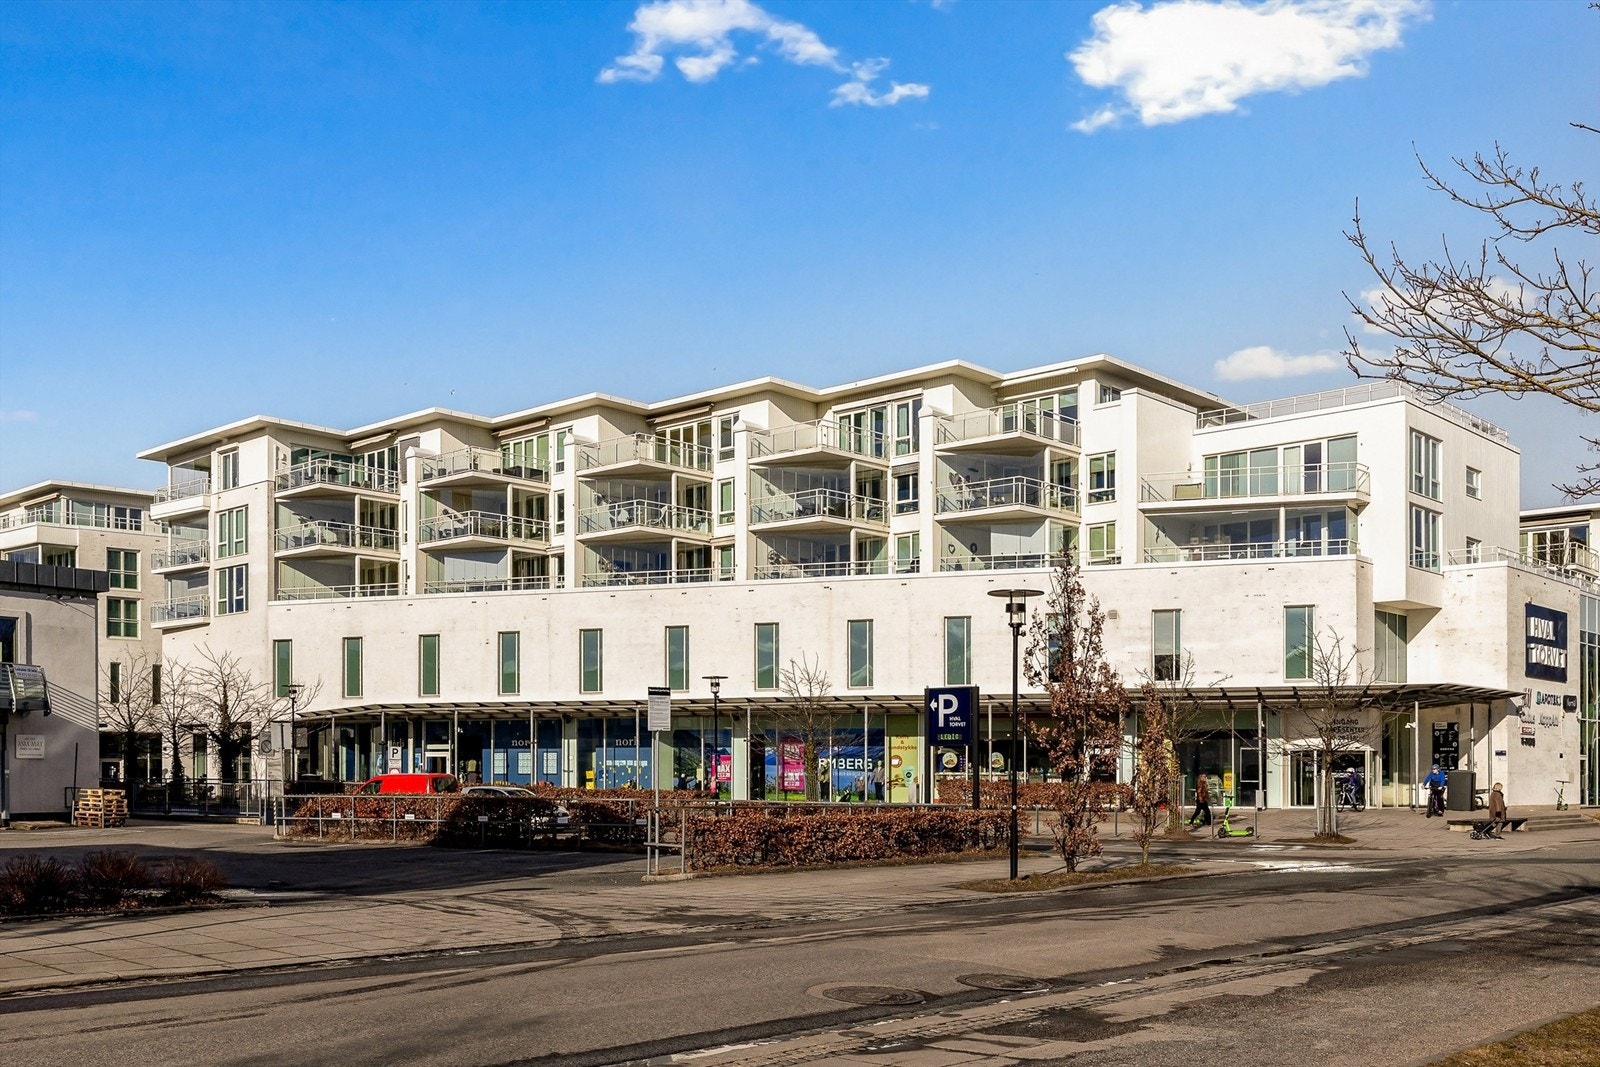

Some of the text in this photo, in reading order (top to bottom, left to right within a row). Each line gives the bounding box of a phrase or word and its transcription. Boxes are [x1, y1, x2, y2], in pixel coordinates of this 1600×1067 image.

[1527, 616, 1555, 641] HVAL
[938, 694, 959, 727] P
[391, 748, 399, 758] P
